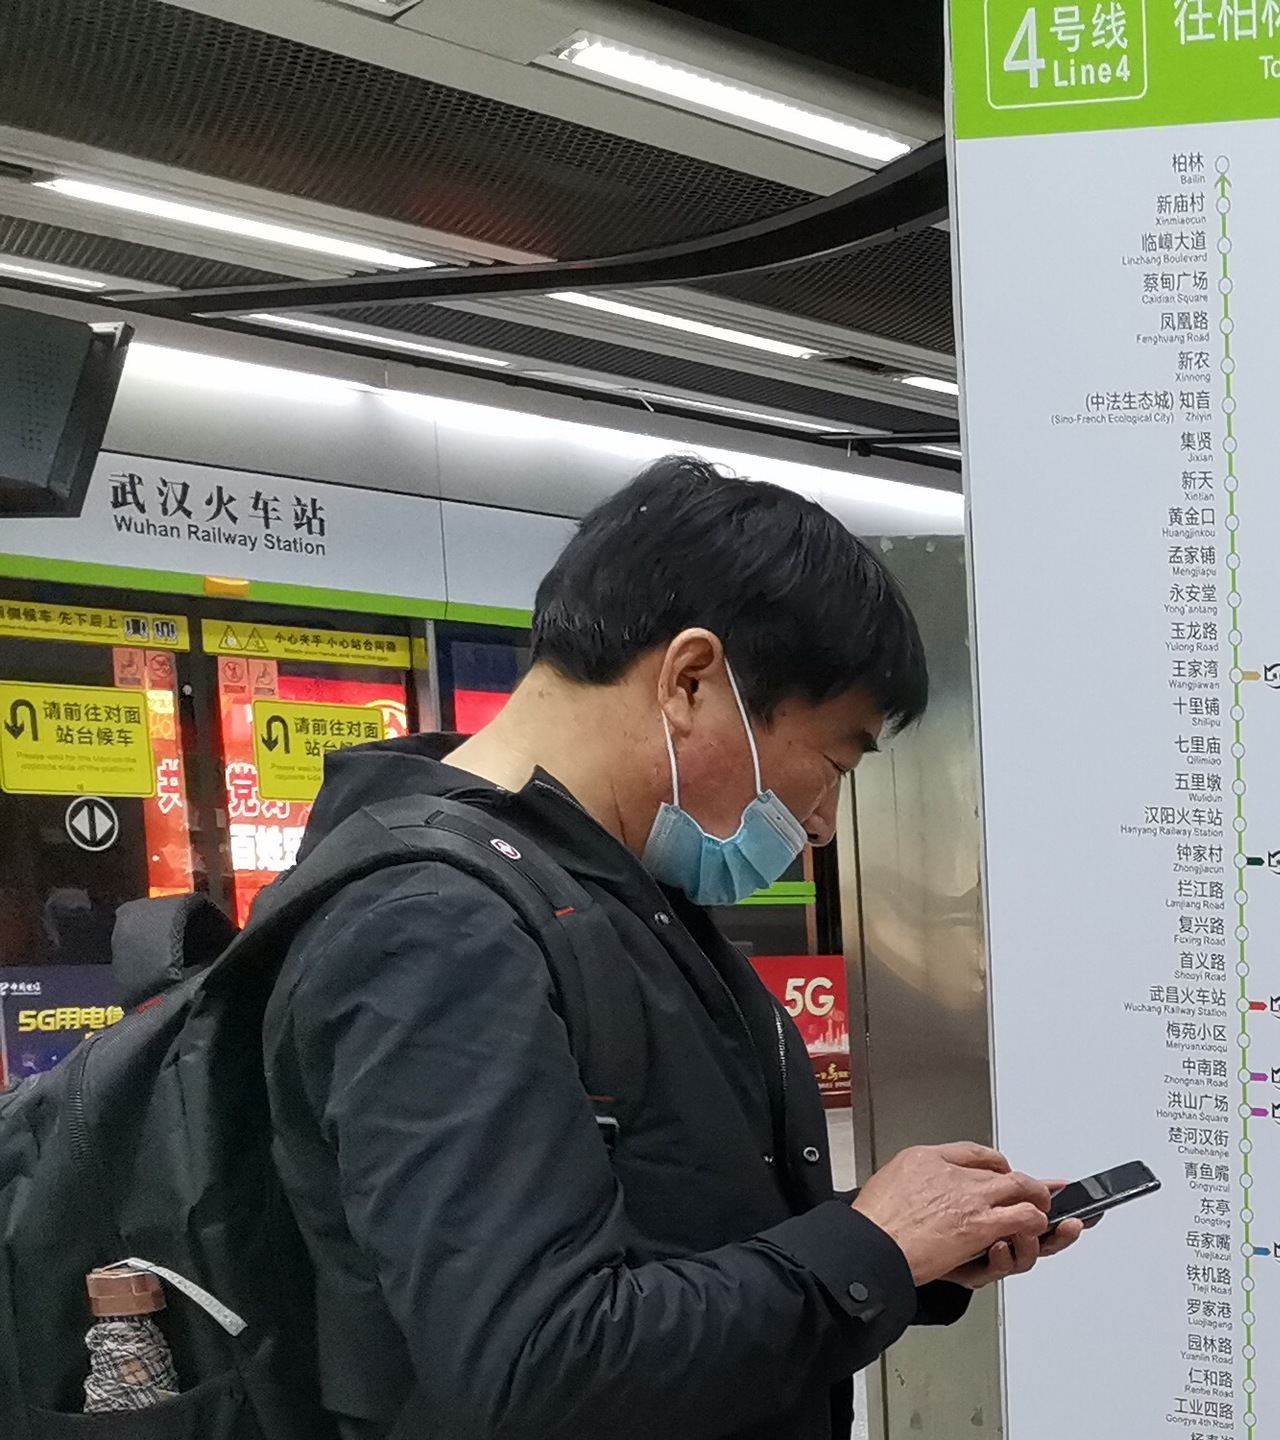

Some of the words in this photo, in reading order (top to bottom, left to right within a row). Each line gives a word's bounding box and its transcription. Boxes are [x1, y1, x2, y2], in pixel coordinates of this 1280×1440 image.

[1052, 54, 1129, 87] Line4
[1172, 153, 1204, 172] 柏林
[1181, 175, 1205, 184] Bailin
[1157, 194, 1205, 214] 新庙村
[1141, 232, 1206, 252] 临嶂大道
[1122, 255, 1161, 266] Linzhang
[1164, 253, 1207, 263] Boulevard
[1143, 272, 1208, 292] 蔡甸广场
[1177, 293, 1208, 304] Square
[1160, 312, 1208, 330] 凤凰路
[1136, 334, 1184, 344] Fenghuang
[1187, 333, 1210, 342] Road
[1178, 352, 1210, 370] 新农
[1175, 373, 1210, 383] Xinnong
[1086, 391, 1174, 411] (中法生态城)
[1179, 391, 1211, 410] 知音
[1181, 432, 1211, 451] 集贤
[1182, 471, 1213, 490] 新天
[109, 471, 327, 539] 武汉火车站
[1168, 508, 1215, 526] 黄金口
[113, 515, 182, 541] Wuhan
[186, 521, 258, 552] Railway
[263, 534, 326, 556] Station
[1168, 546, 1216, 565] 孟家铺
[1170, 584, 1217, 602] 永安堂
[1171, 622, 1218, 641] 玉龙路
[1166, 642, 1194, 653] Yulong
[1197, 642, 1219, 651] Road
[1172, 660, 1218, 678] 王家湾
[42, 700, 141, 724] 请前往对面
[1173, 698, 1219, 716] 十里铺
[56, 725, 134, 747] 站台候车
[294, 716, 378, 738] 请前往对面
[1174, 736, 1220, 754] 七里庙
[1175, 773, 1221, 792] 五里墩
[1144, 807, 1222, 826] 汉阳火车站
[1177, 844, 1222, 863] 钟家村
[1178, 880, 1224, 899] 拦江路
[1202, 900, 1224, 910] Road
[1179, 916, 1224, 935] 复兴路
[1204, 936, 1226, 946] Road
[1179, 952, 1226, 971] 首义路
[1204, 972, 1226, 982] Road
[784, 977, 834, 1017] 5G
[1149, 986, 1226, 1007] 武昌火车站
[1166, 1022, 1227, 1042] 梅苑小区
[1182, 1058, 1227, 1078] 中南路
[1205, 1078, 1228, 1088] Road
[1168, 1092, 1228, 1113] 洪山广场
[1168, 1128, 1228, 1147] 楚河汉街
[1200, 1198, 1230, 1217] 东亭
[1185, 1232, 1231, 1251] 岳家嘴
[1186, 1265, 1231, 1285] 铁机路
[1213, 1284, 1232, 1296] Road
[1186, 1299, 1232, 1319] 罗家港
[1188, 1334, 1233, 1354] 园林路
[1212, 1354, 1234, 1365] Road
[1188, 1368, 1233, 1388] 仁和路
[1214, 1387, 1234, 1398] Road
[1174, 1398, 1234, 1420] 工业四路
[1213, 1419, 1234, 1430] Road
